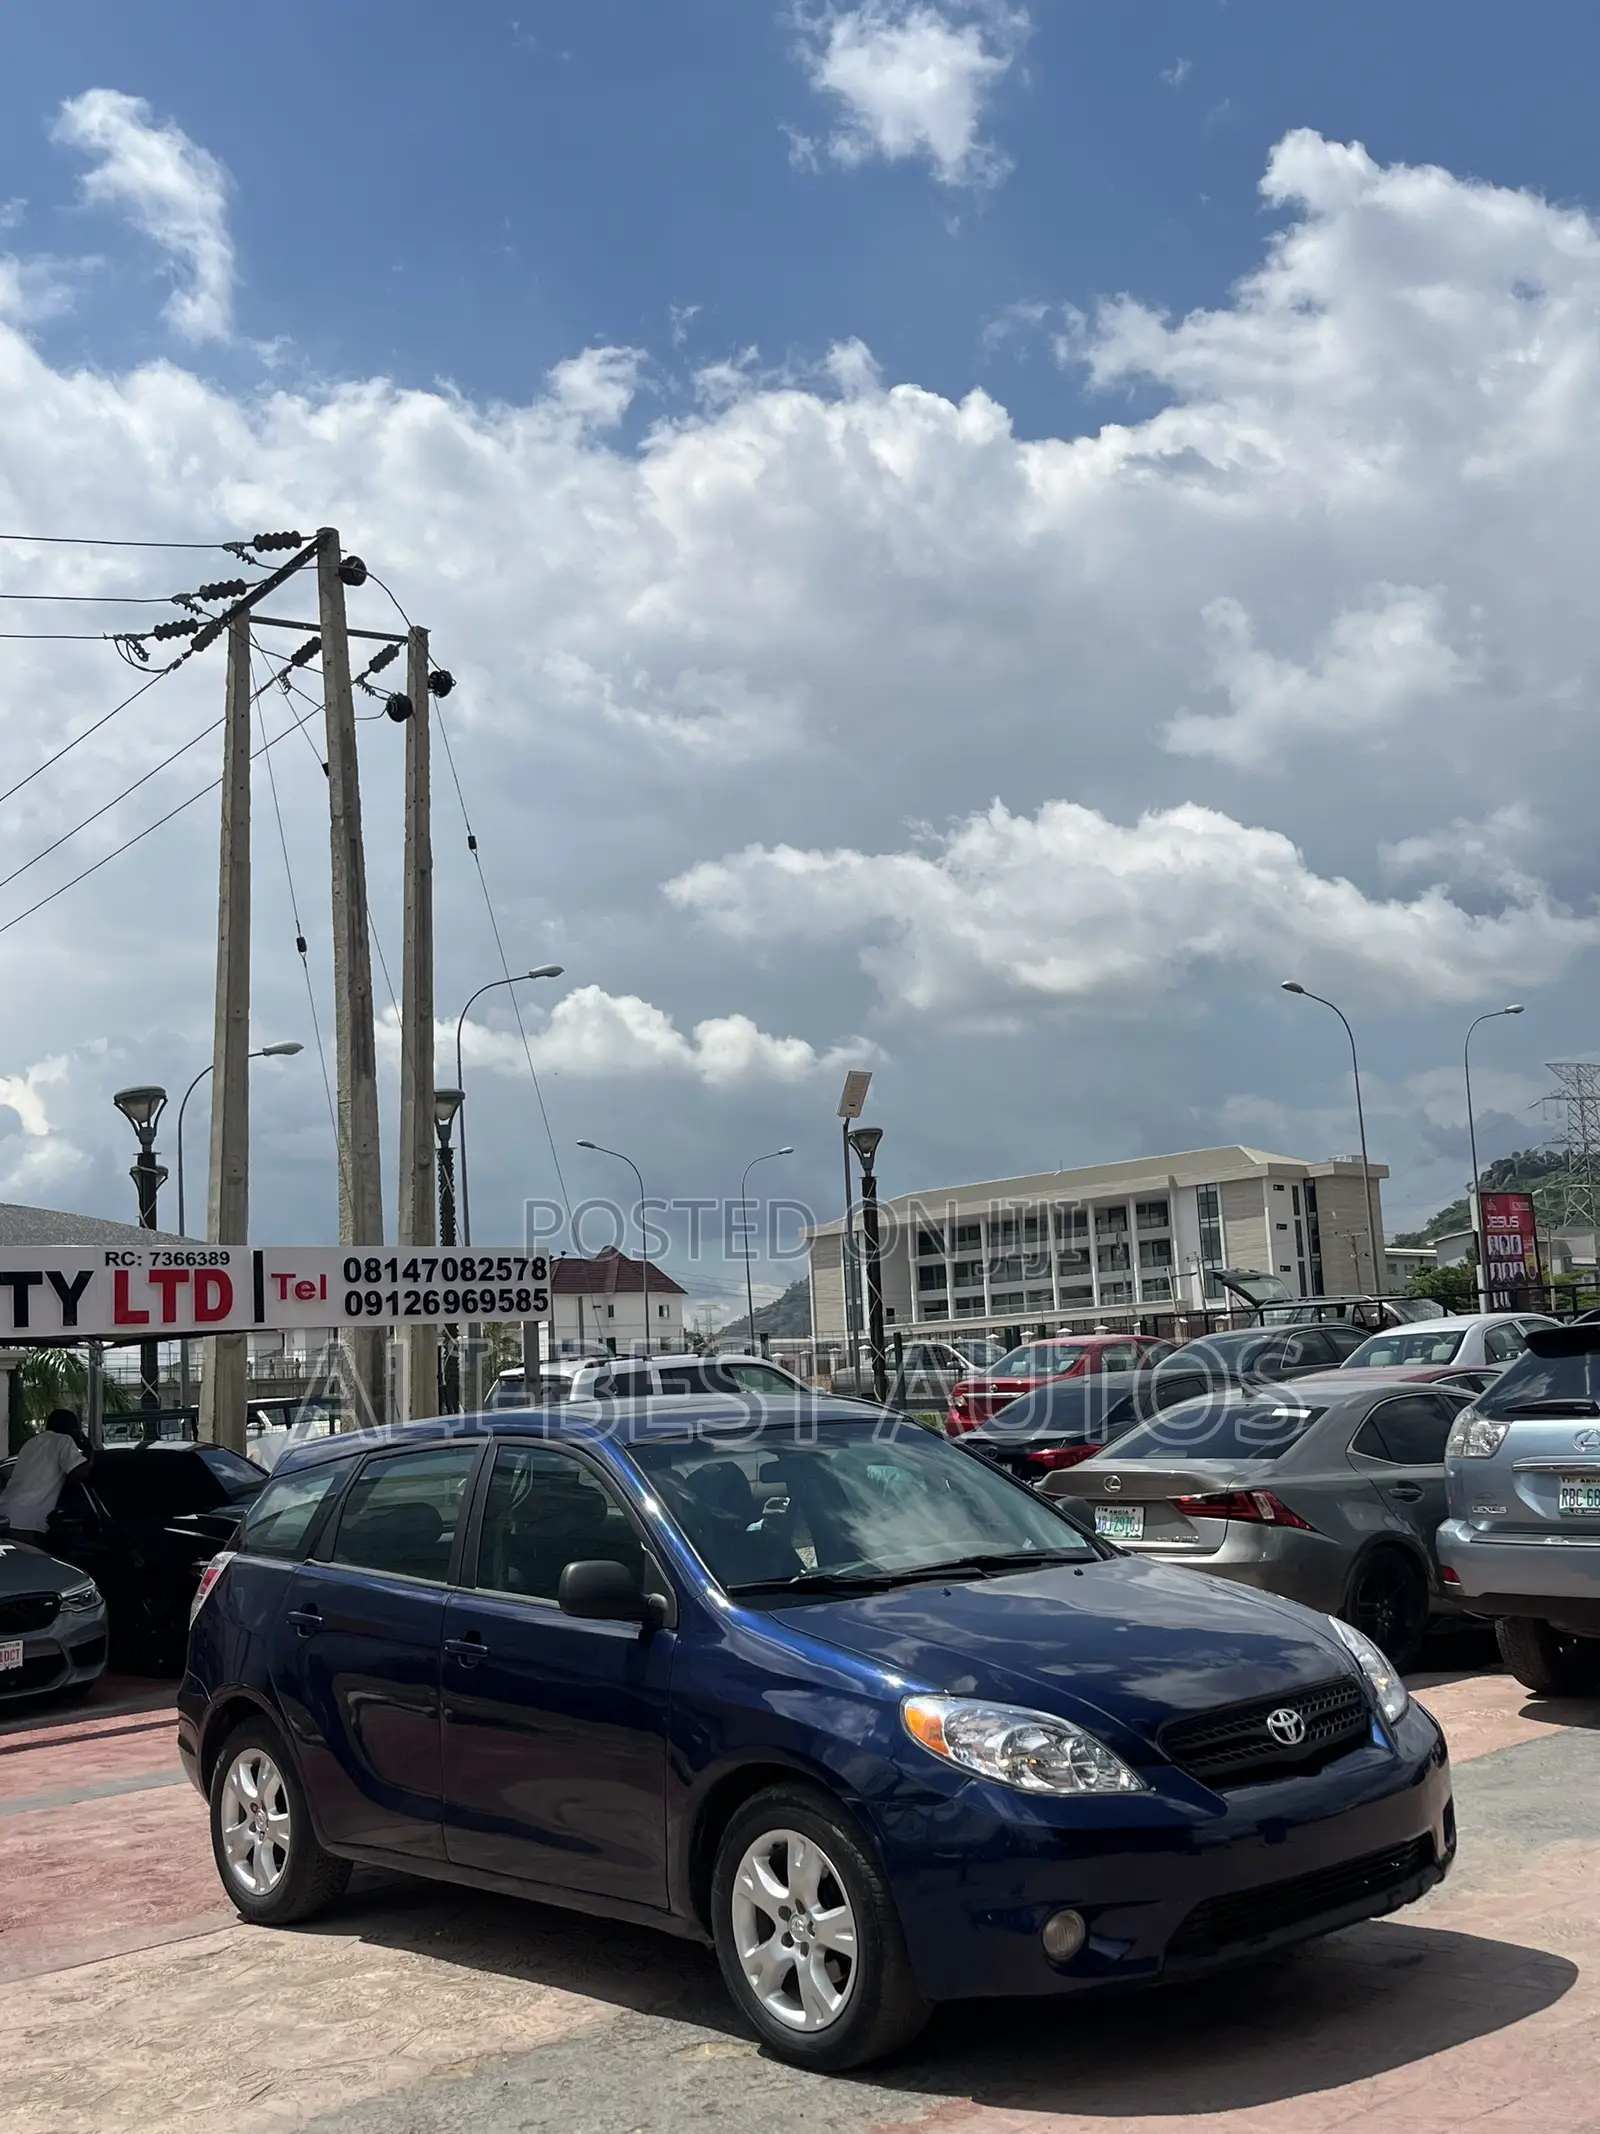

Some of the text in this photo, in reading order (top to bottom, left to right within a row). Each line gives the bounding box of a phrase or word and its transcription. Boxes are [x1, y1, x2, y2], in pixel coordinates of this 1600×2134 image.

[104, 1251, 231, 1267] RC: 7366389
[343, 1257, 548, 1284] 08147082578
[114, 1269, 233, 1325] LTD
[270, 1273, 327, 1301] Tel
[344, 1288, 549, 1317] 09126969585
[1472, 1505, 1507, 1515] LEXUS
